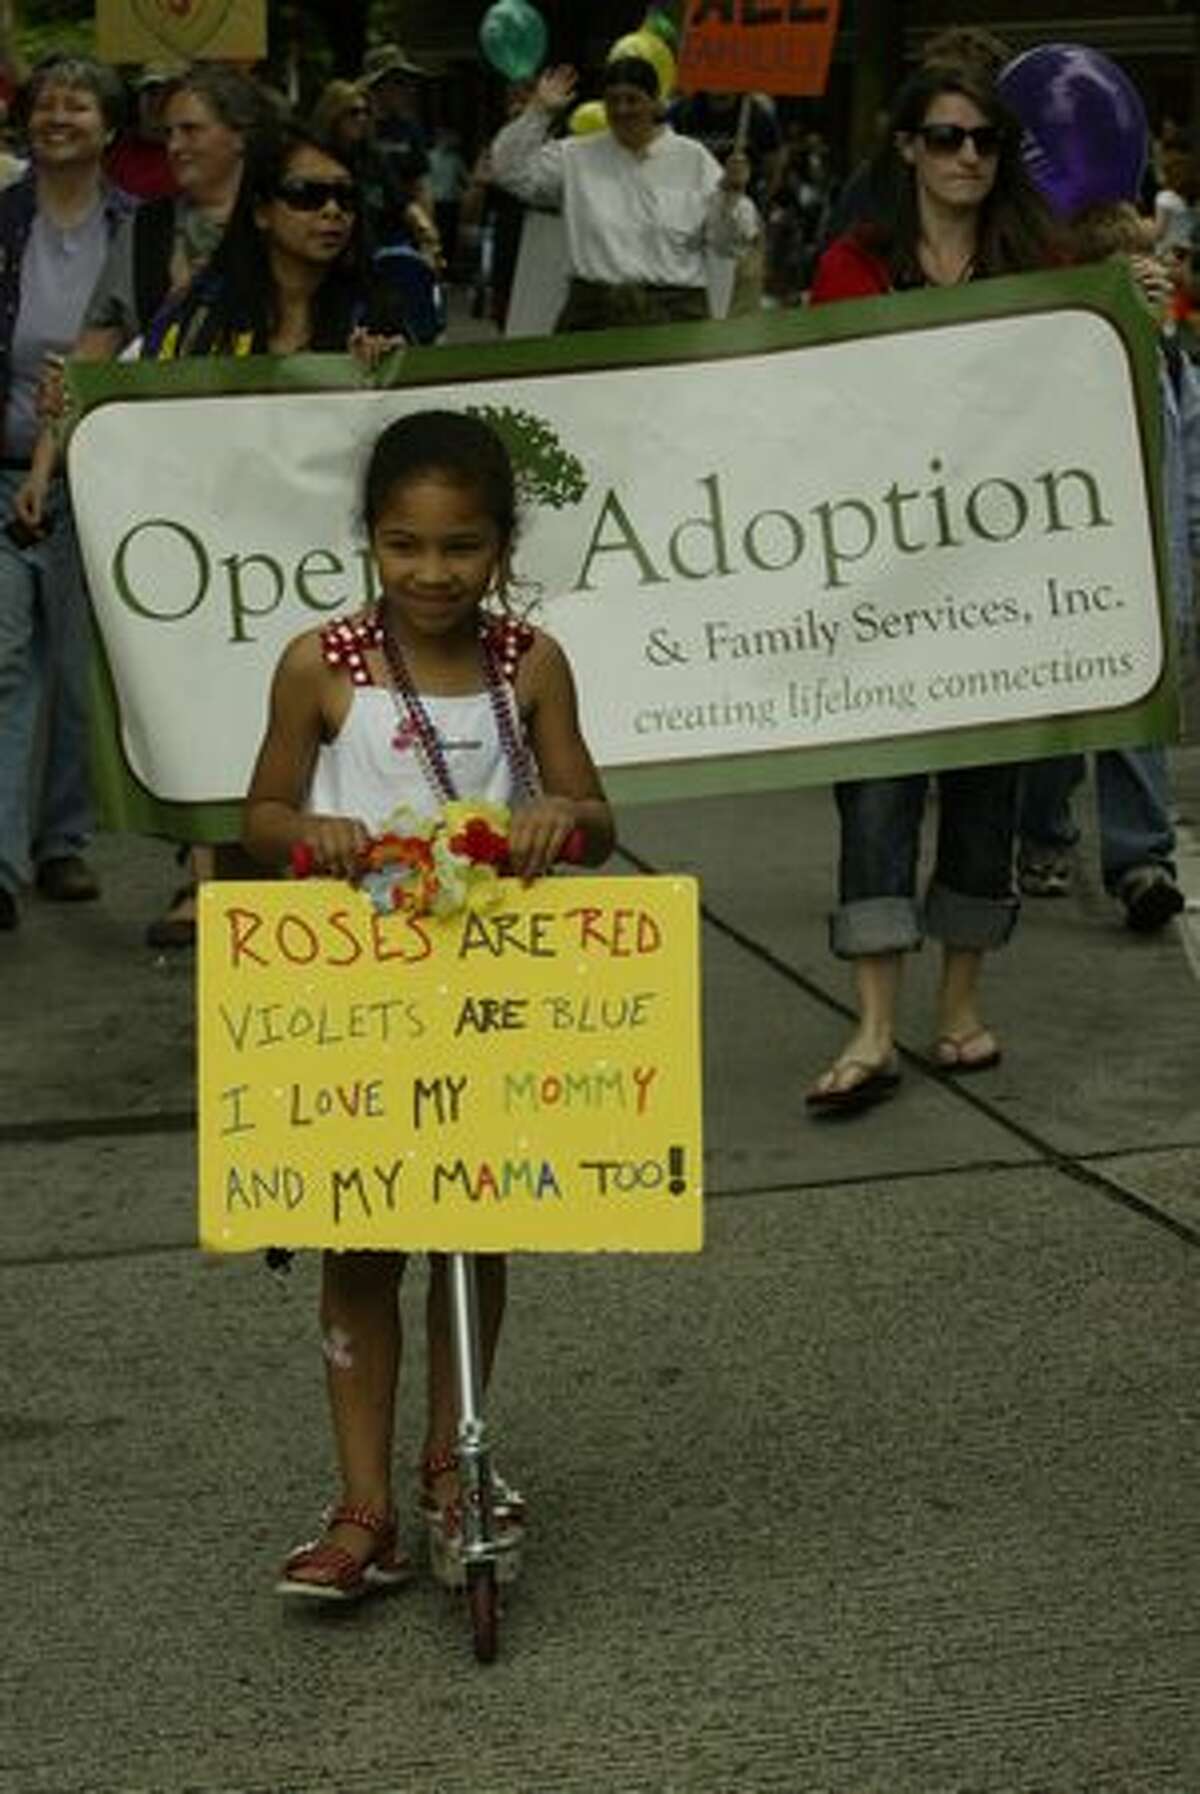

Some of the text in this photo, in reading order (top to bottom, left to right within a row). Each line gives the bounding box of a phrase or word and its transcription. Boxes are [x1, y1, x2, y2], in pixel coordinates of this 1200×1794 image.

[571, 458, 1113, 592] Adoption
[644, 577, 1126, 668] & Family Services, Inc.
[633, 648, 1136, 736] creating lifelong connections
[226, 907, 662, 968] ROSES ARE RED
[219, 993, 656, 1051] VIOLETS ARE BLUE
[221, 1066, 657, 1136] I LOVE MY MOMMY
[225, 1145, 687, 1224] AND MY MAMA TOO!
